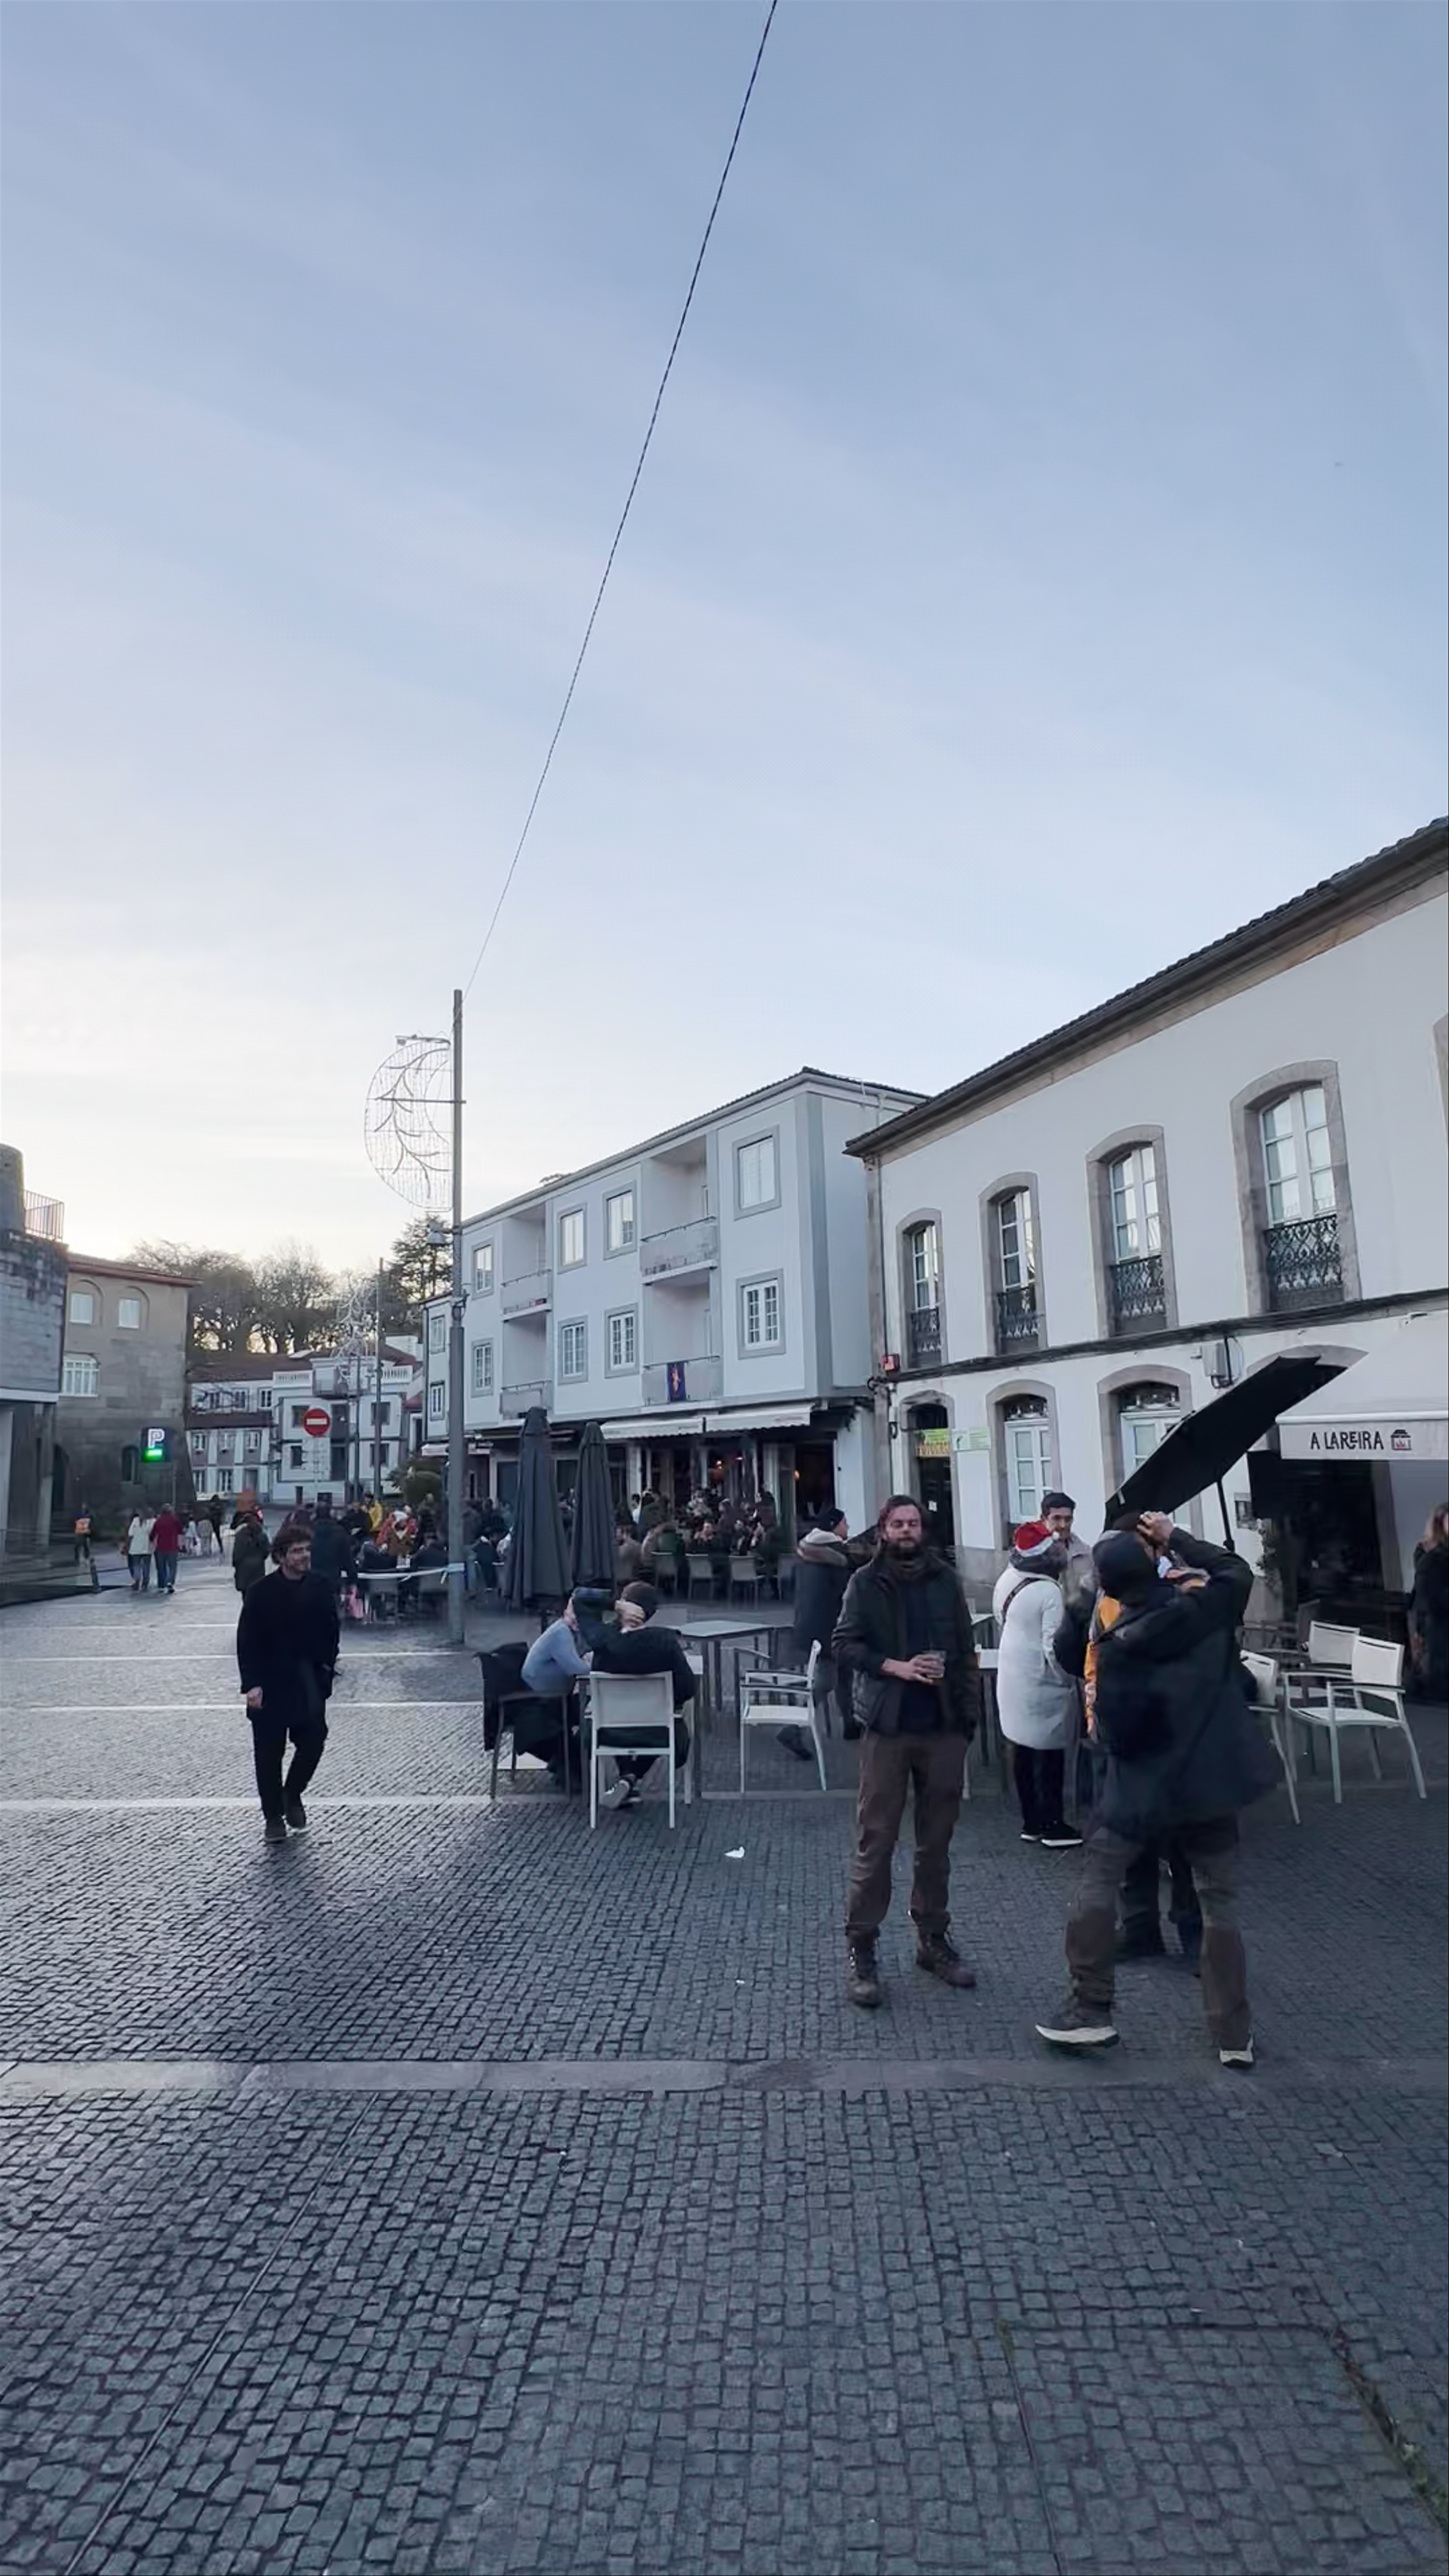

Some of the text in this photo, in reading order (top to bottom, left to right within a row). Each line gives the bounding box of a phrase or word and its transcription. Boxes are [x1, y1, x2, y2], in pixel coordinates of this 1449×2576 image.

[148, 1429, 165, 1449] P
[1311, 1430, 1384, 1450] A LAREIRA
